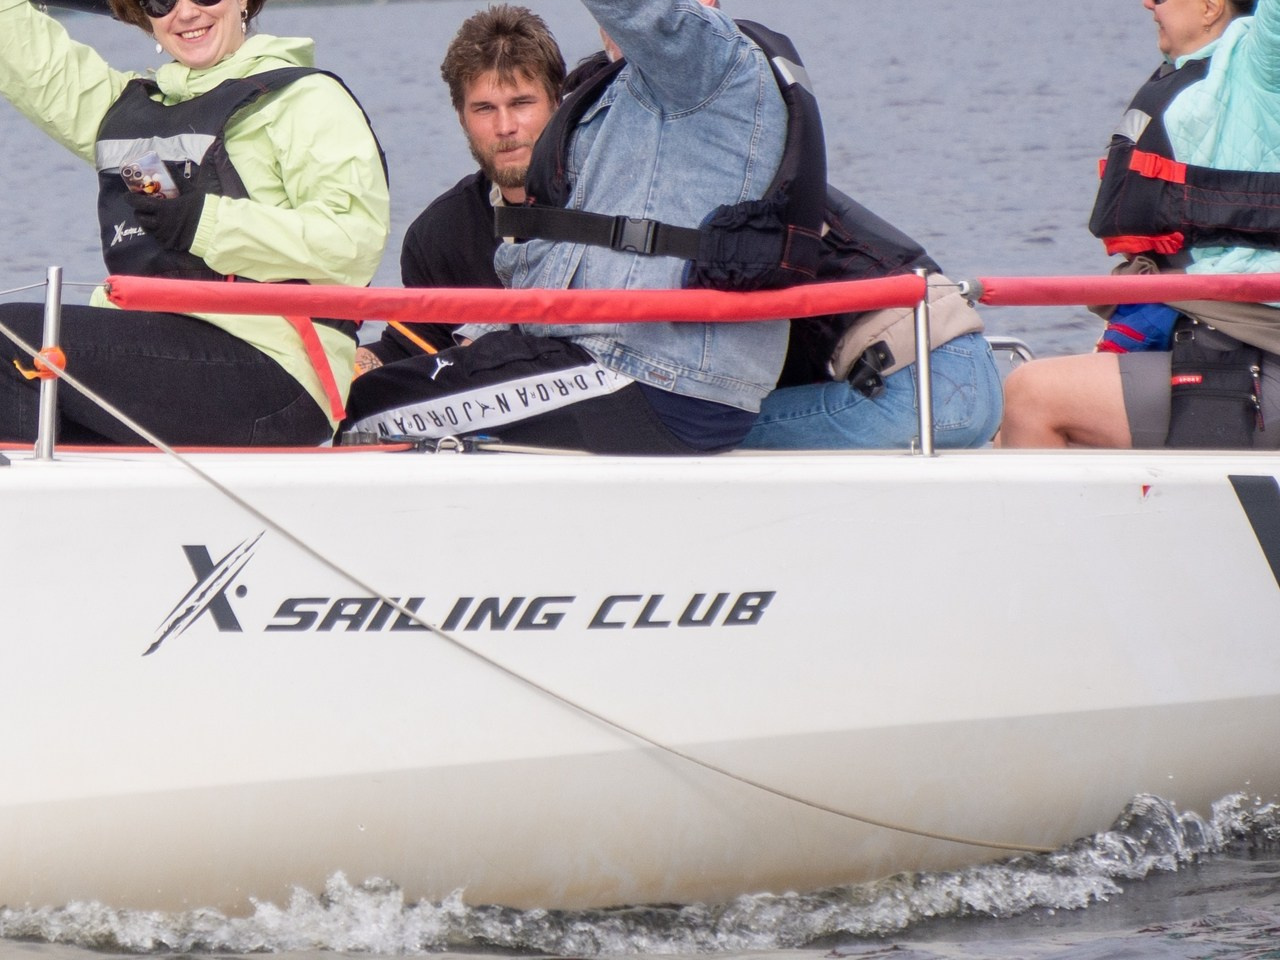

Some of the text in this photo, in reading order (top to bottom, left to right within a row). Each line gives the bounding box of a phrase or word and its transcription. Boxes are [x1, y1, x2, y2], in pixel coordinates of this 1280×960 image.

[496, 369, 606, 414] JORDAN
[377, 401, 472, 437] JORDAN
[263, 595, 577, 632] SAILING
[586, 590, 777, 630] CLUB
